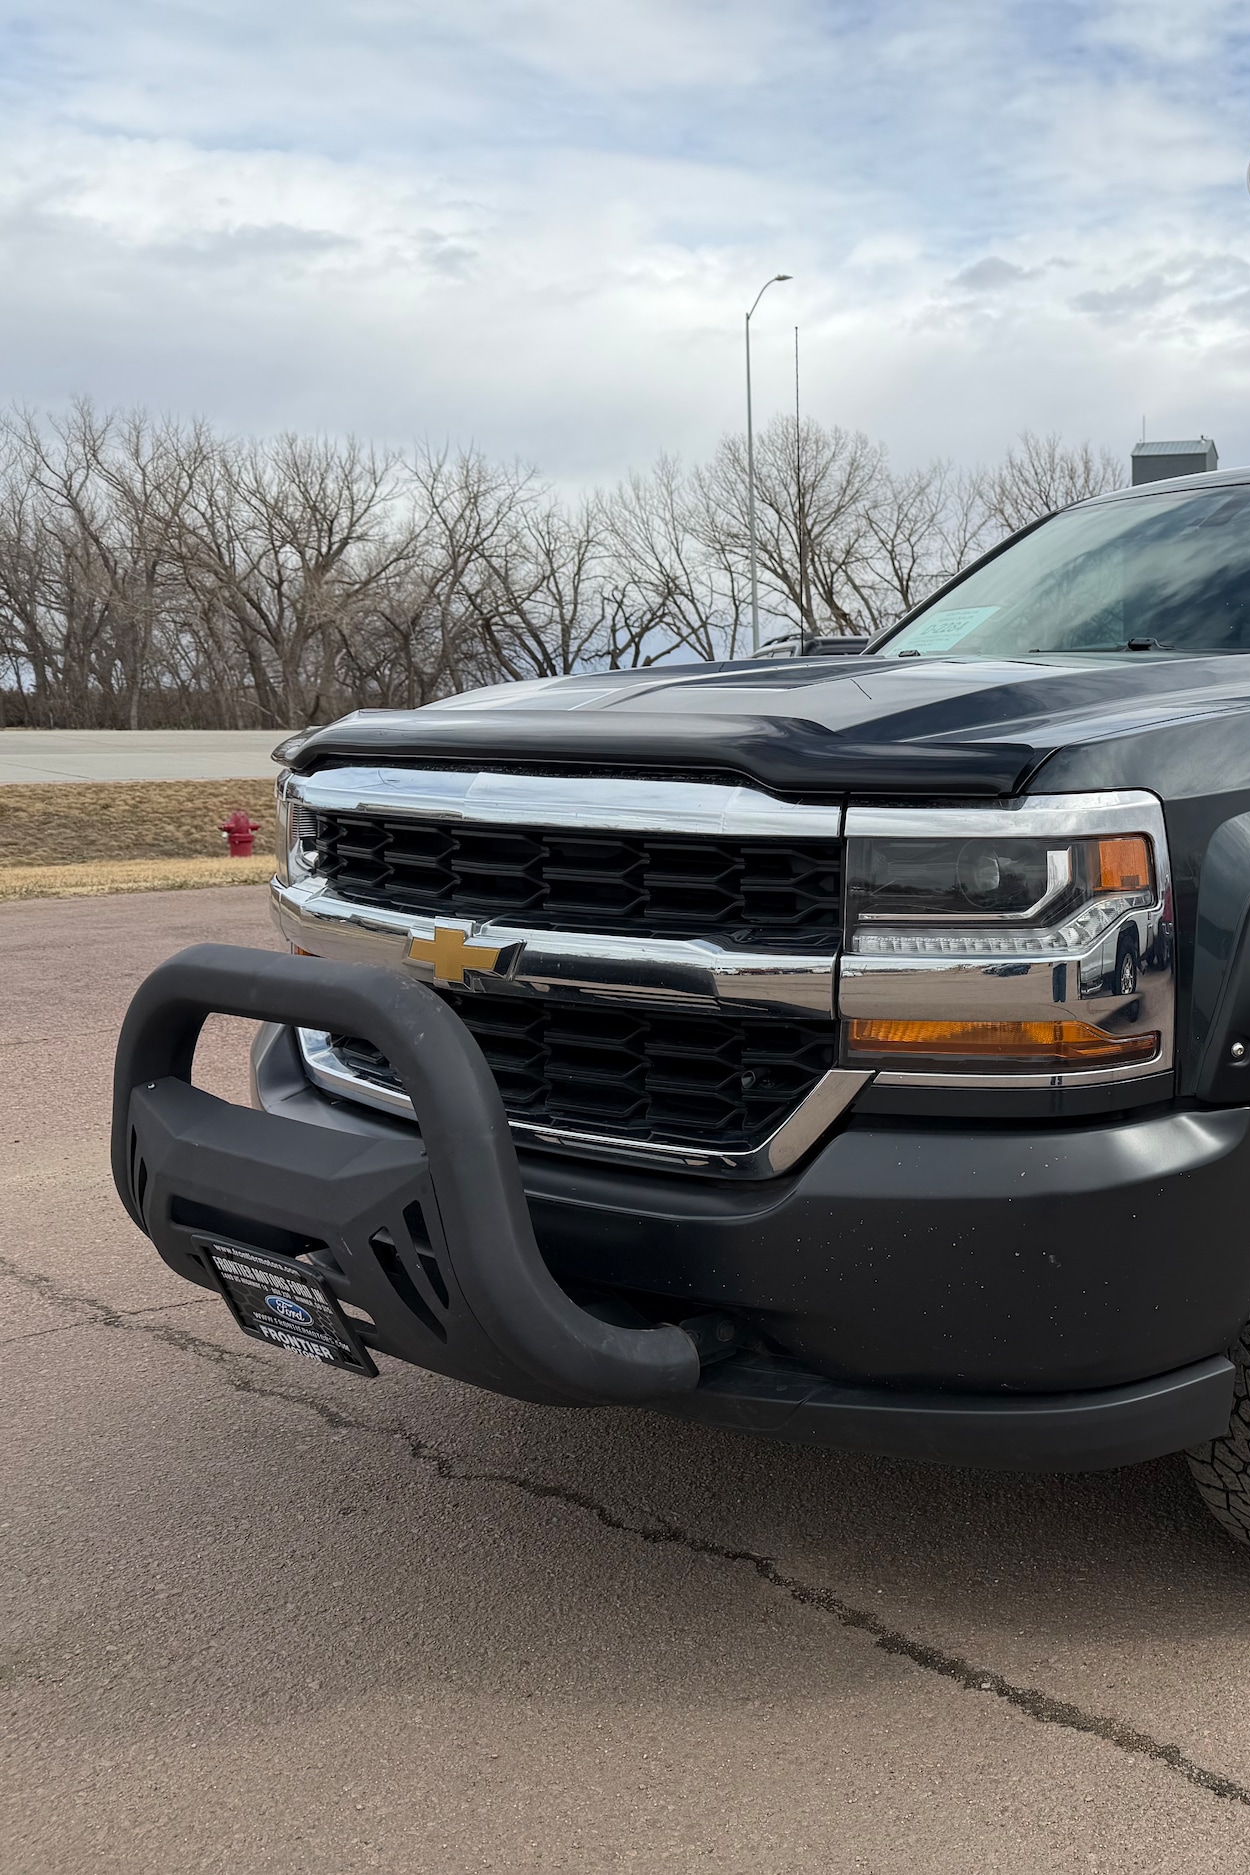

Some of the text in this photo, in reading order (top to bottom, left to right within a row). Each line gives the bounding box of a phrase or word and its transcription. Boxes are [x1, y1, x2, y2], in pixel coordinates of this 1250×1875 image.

[212, 1255, 256, 1280] FRONTIER
[251, 1267, 290, 1292] MOTORS
[275, 1299, 305, 1322] Ford
[259, 1324, 334, 1360] FRONTIER
[283, 1343, 323, 1362] MOTORS
